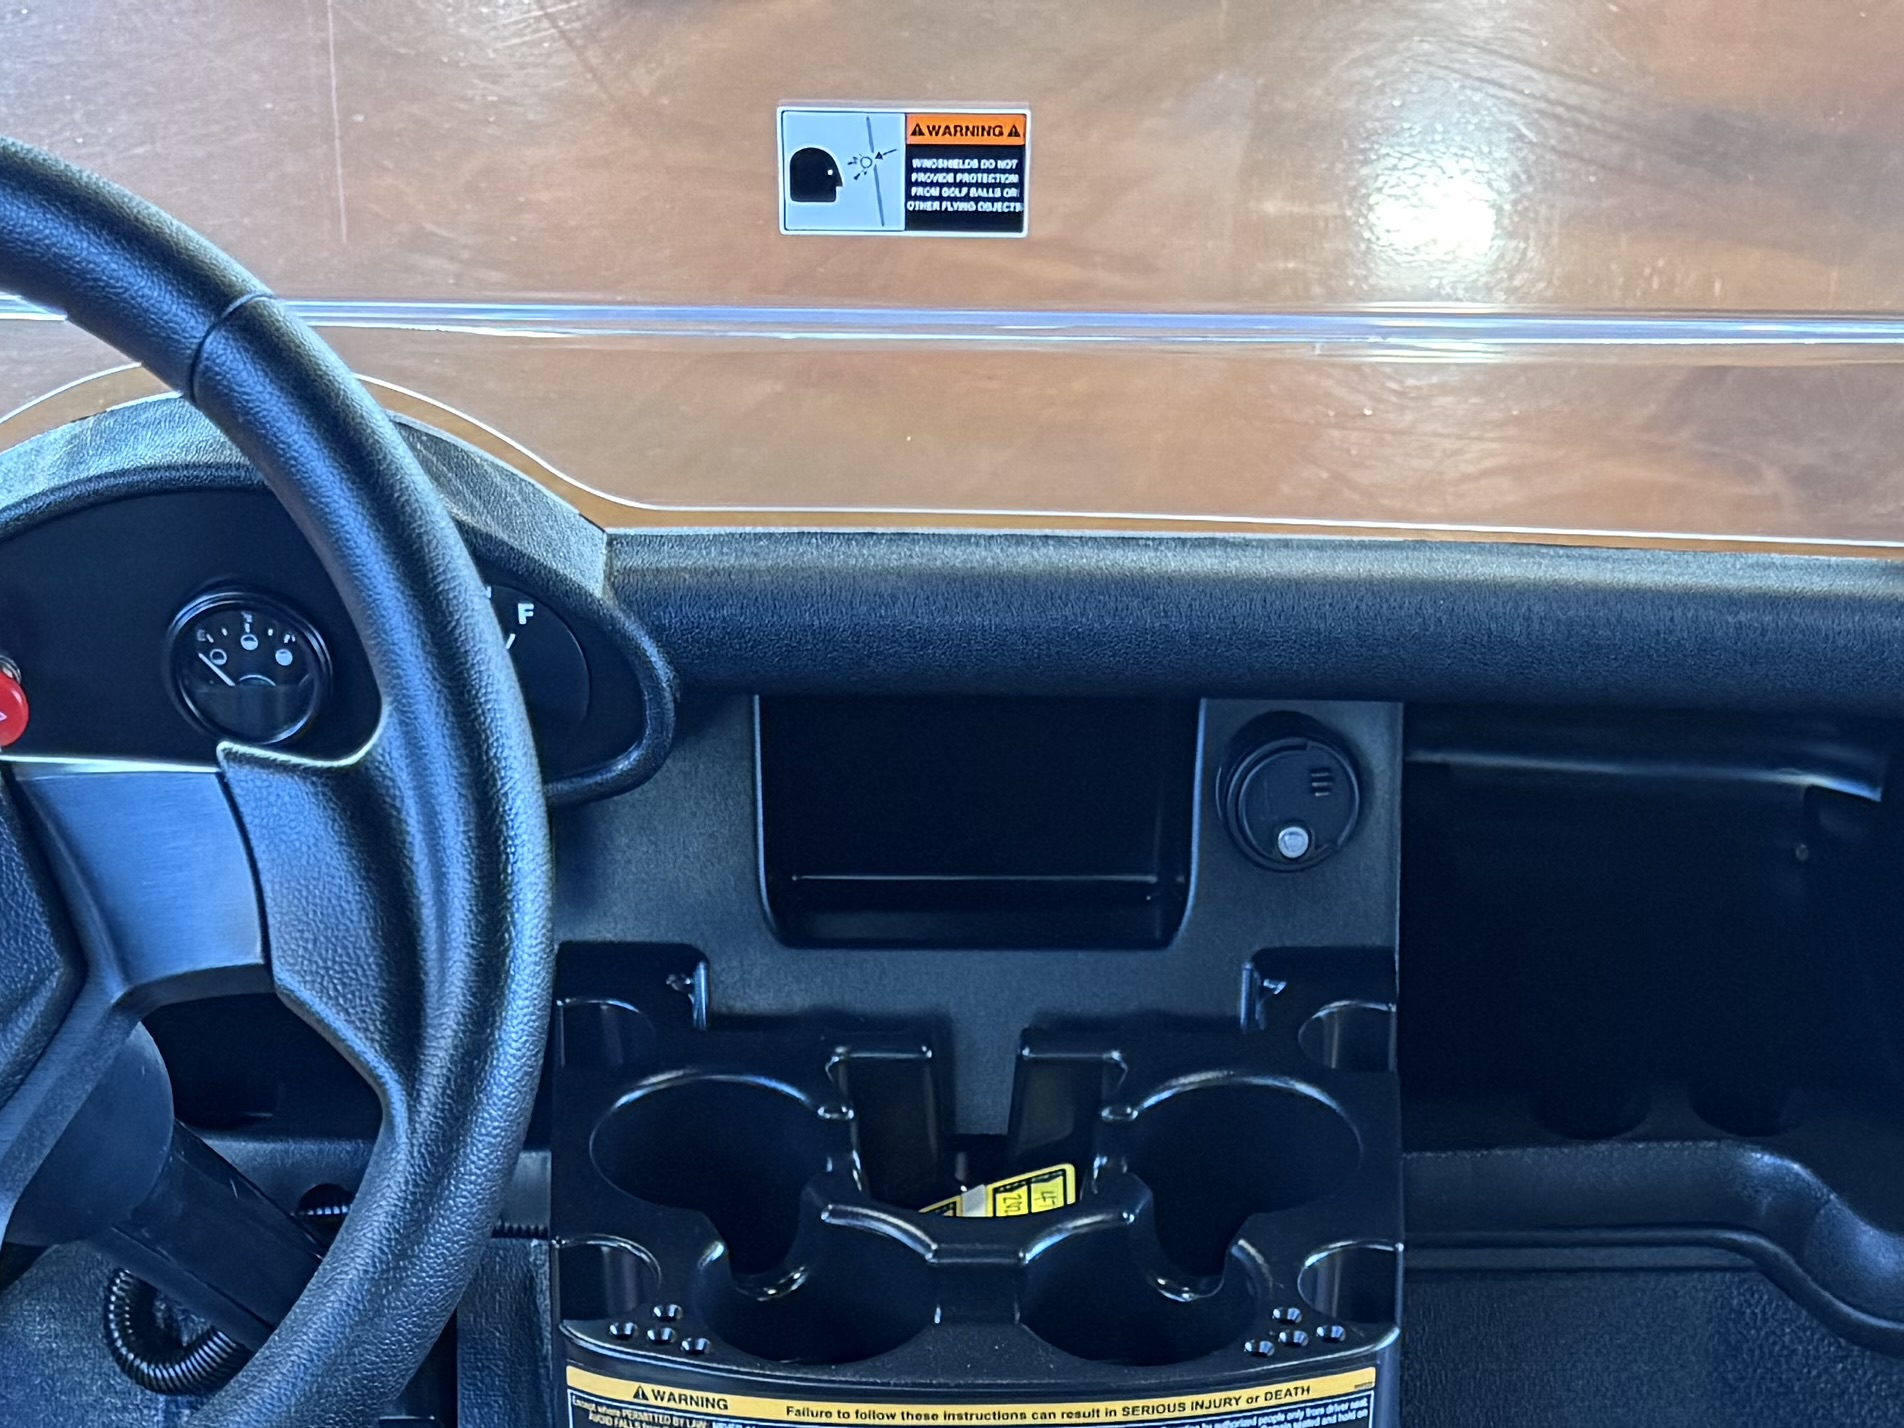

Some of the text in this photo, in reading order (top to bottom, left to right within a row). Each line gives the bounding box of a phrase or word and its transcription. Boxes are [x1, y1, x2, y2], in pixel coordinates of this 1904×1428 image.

[927, 124, 1004, 137] WARNING
[981, 159, 996, 169] DO
[997, 159, 1018, 169] NOT
[911, 186, 940, 197] FROM
[906, 201, 940, 211] OTHER
[517, 603, 535, 625] F
[651, 1388, 728, 1410] WARNING
[785, 1385, 1310, 1421] Failure to follow these instructions can result in SERIOUS INJURY or DEATH
